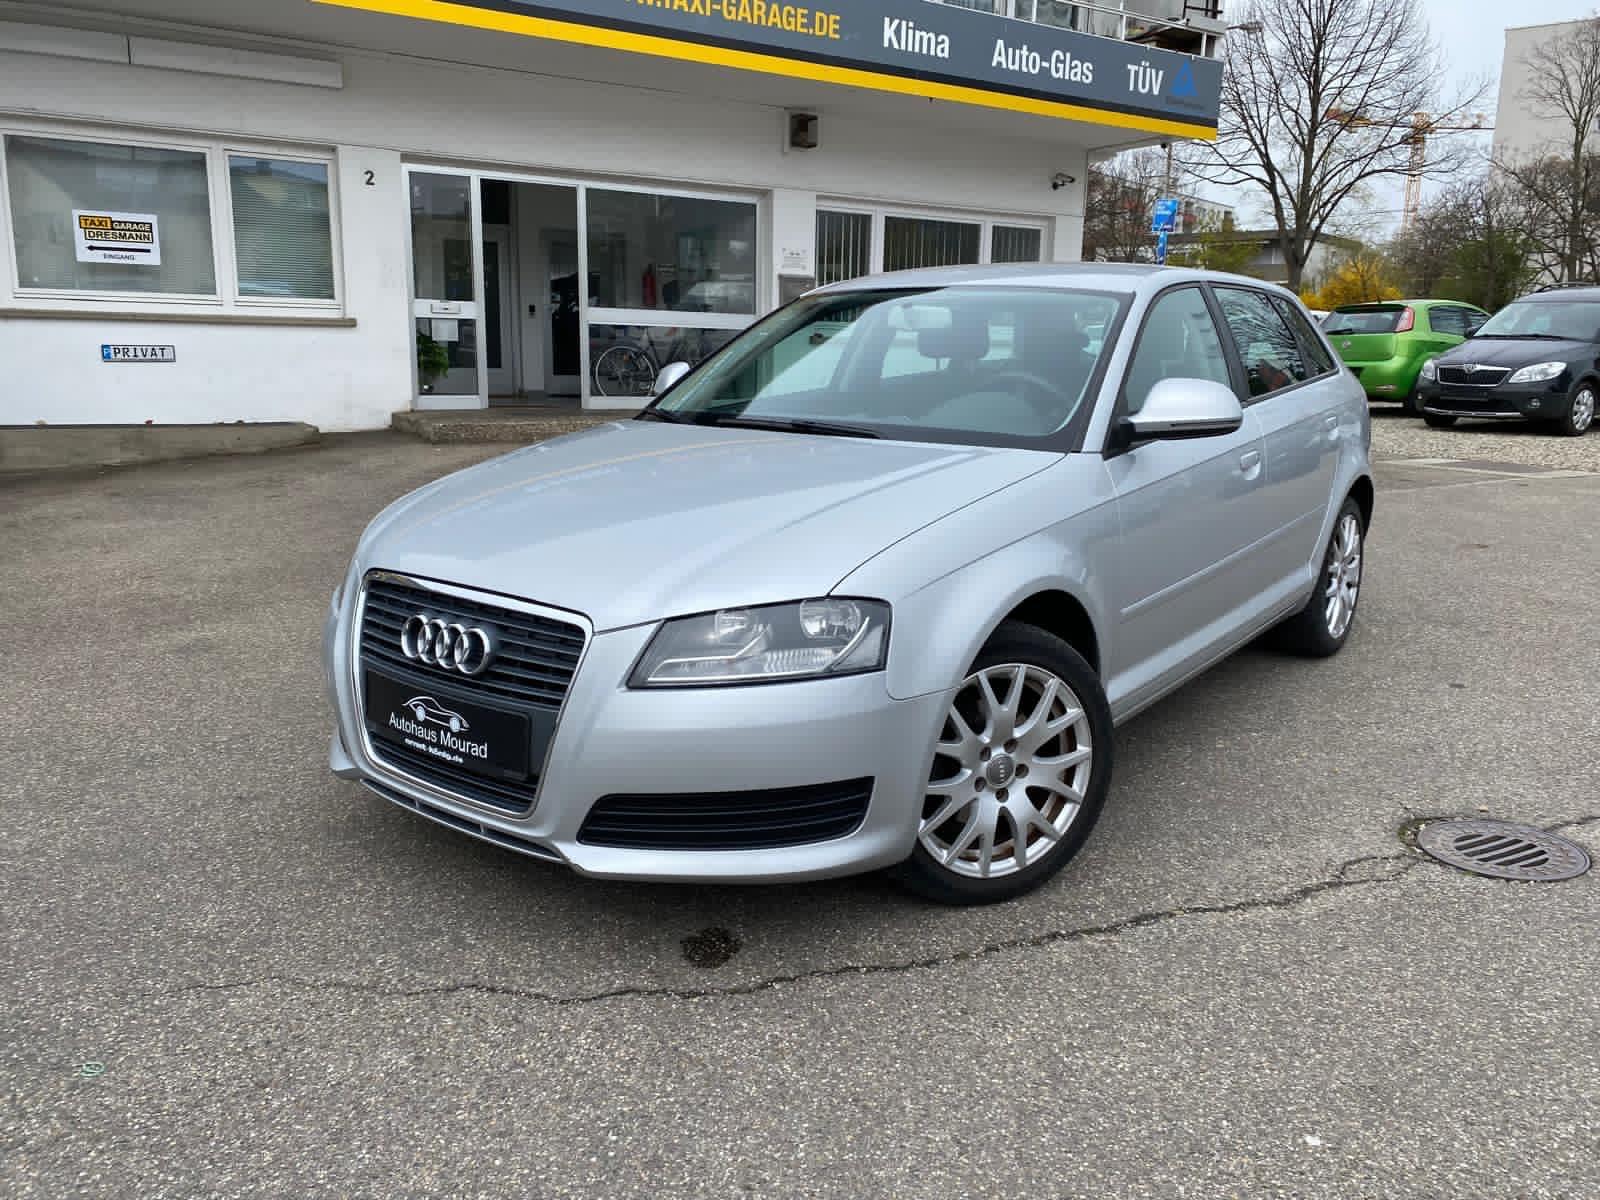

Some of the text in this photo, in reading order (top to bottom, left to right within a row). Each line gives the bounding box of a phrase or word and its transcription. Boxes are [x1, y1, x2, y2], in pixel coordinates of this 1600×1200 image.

[624, 0, 840, 39] .XI-GARAGE.DE
[883, 16, 950, 59] Klima
[992, 39, 1094, 84] Auto-Glas
[1127, 60, 1165, 96] TÜV
[363, 169, 376, 186] 2
[80, 217, 151, 231] TAXI GARAGE
[87, 230, 151, 241] DRESMANN
[112, 347, 166, 358] PRIVAT
[388, 711, 488, 759] Autohaus Mourad
